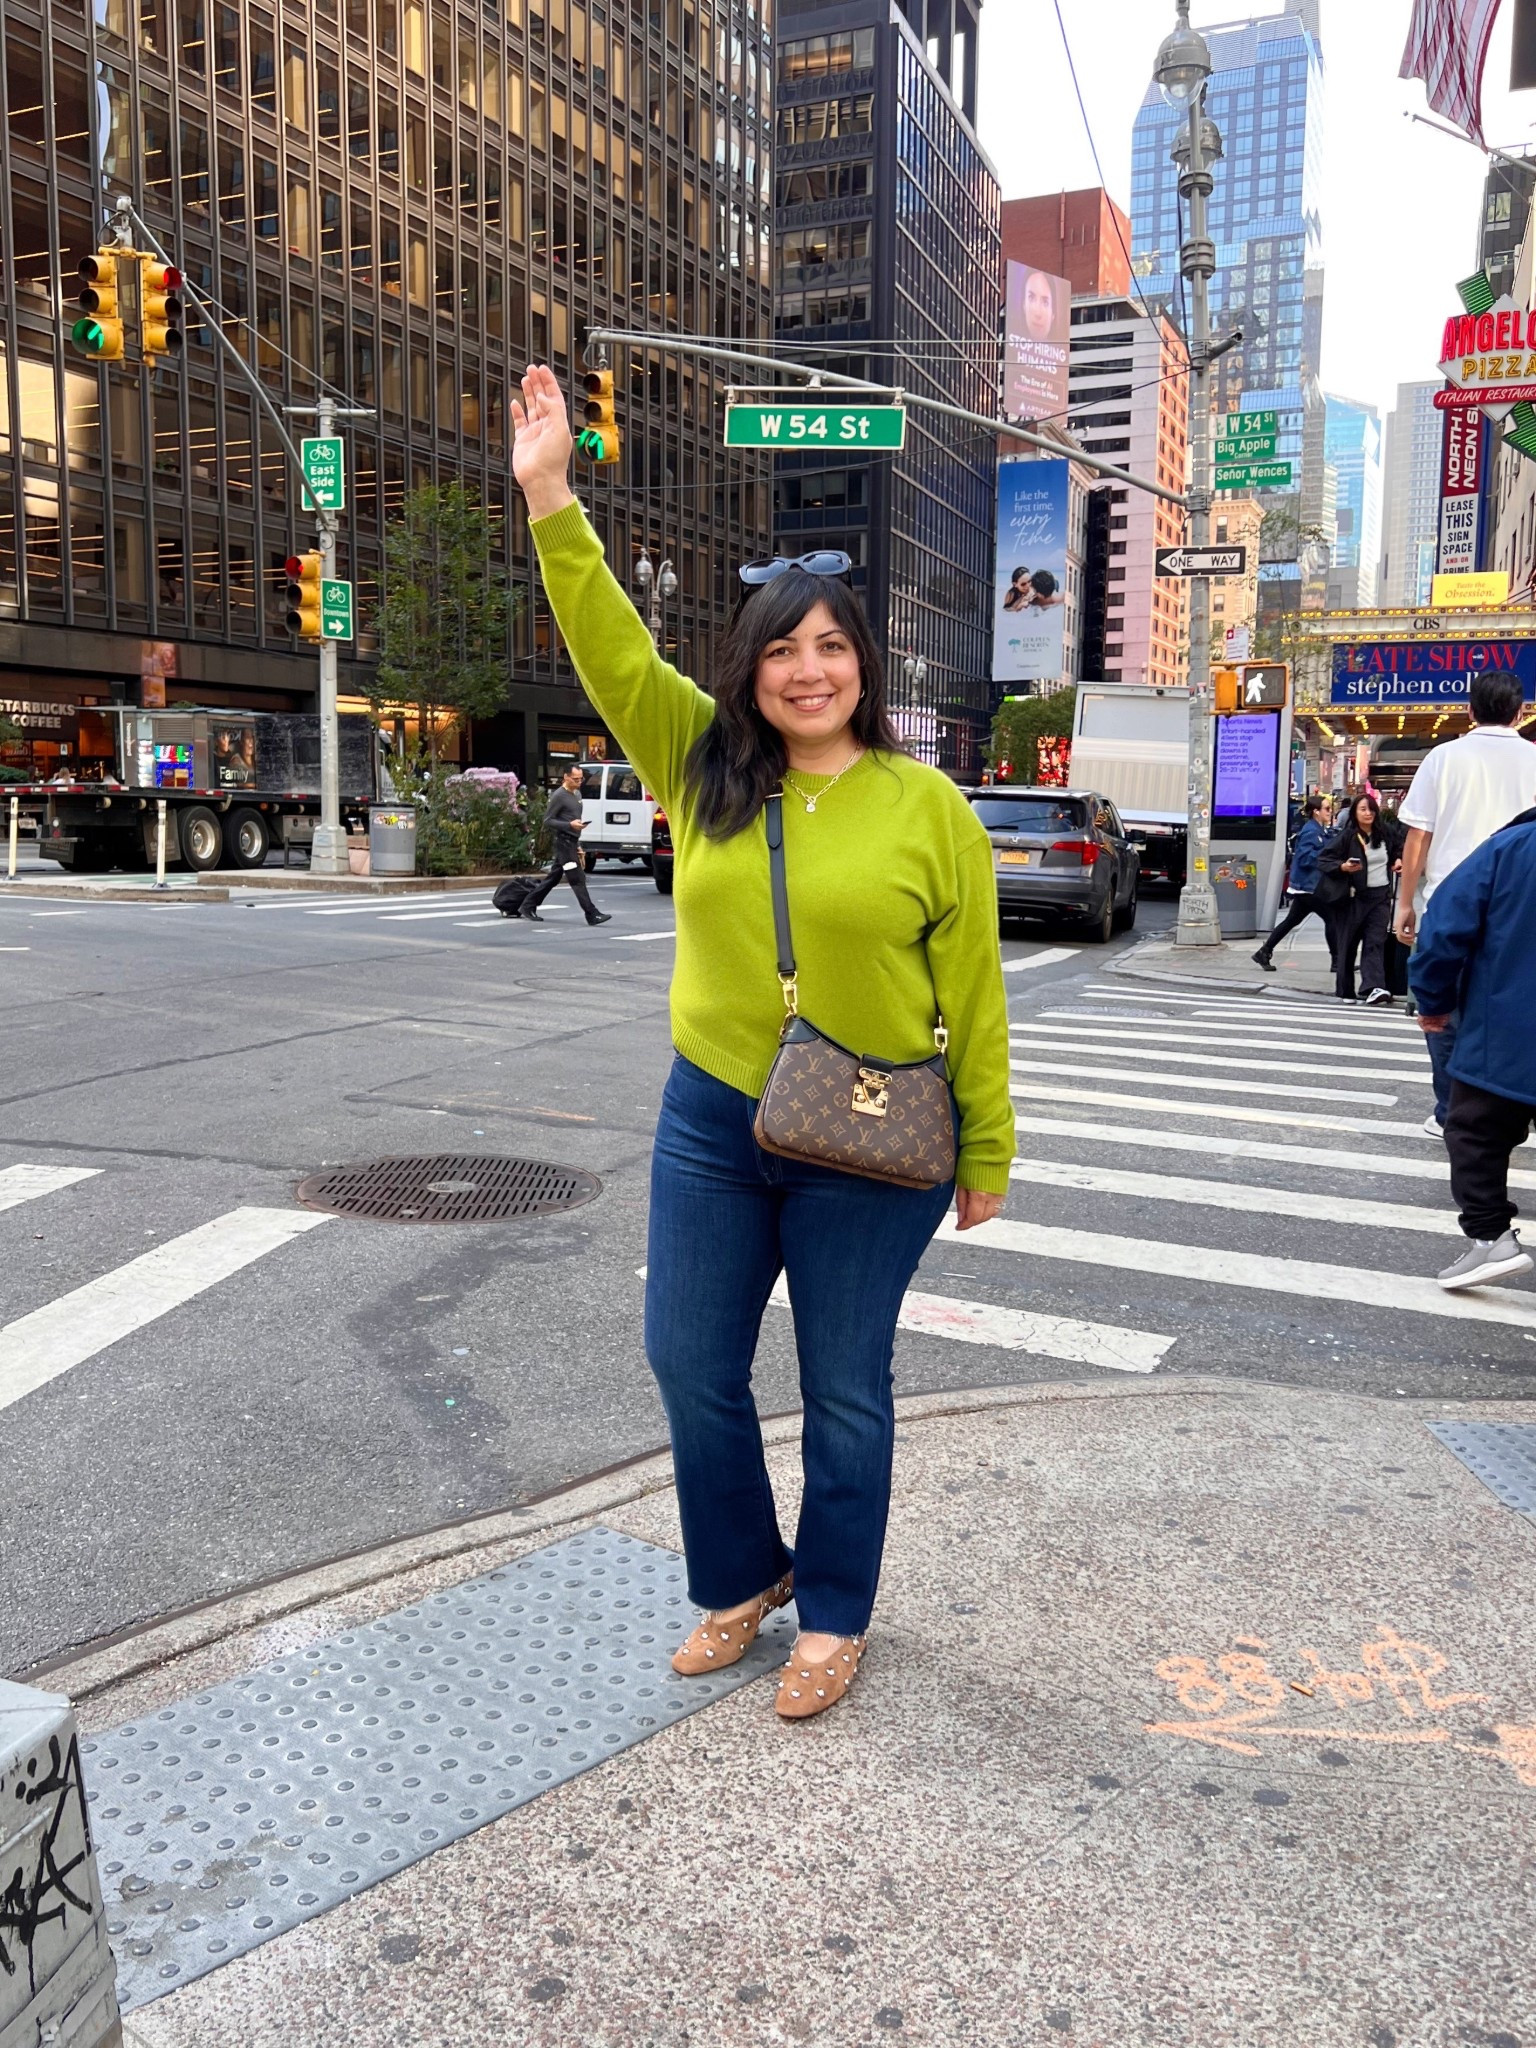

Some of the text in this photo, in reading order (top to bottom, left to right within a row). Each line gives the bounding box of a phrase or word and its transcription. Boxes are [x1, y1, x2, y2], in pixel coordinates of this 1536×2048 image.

[1009, 334, 1066, 362] STOP HIRING
[1017, 352, 1057, 374] HUMANS
[1462, 354, 1536, 380] PIZZA
[1438, 386, 1536, 404] ITALIAN RESTAUR
[760, 414, 871, 440] W 54 St
[1229, 412, 1273, 433] W 54 St
[1217, 438, 1270, 456] Big Apple
[1447, 416, 1462, 488] NORTH
[1463, 428, 1478, 488] NEON
[310, 465, 335, 475] East
[1216, 466, 1288, 481] Señor Wences
[310, 476, 335, 488] Side
[1014, 489, 1049, 501] Like the
[1014, 502, 1031, 513] first
[1446, 500, 1474, 512] LEASE
[1010, 513, 1052, 534] every
[1446, 512, 1474, 529] THIS
[1013, 525, 1056, 553] time
[1447, 531, 1469, 542] SIGN
[1443, 542, 1473, 555] SPACE
[1170, 554, 1236, 568] ONE WAY
[1413, 617, 1440, 630] CBS
[1346, 644, 1525, 673] LATE SHOW
[1347, 673, 1434, 702] stephen
[12, 714, 61, 728] COFFEE
[219, 766, 249, 783] Family
